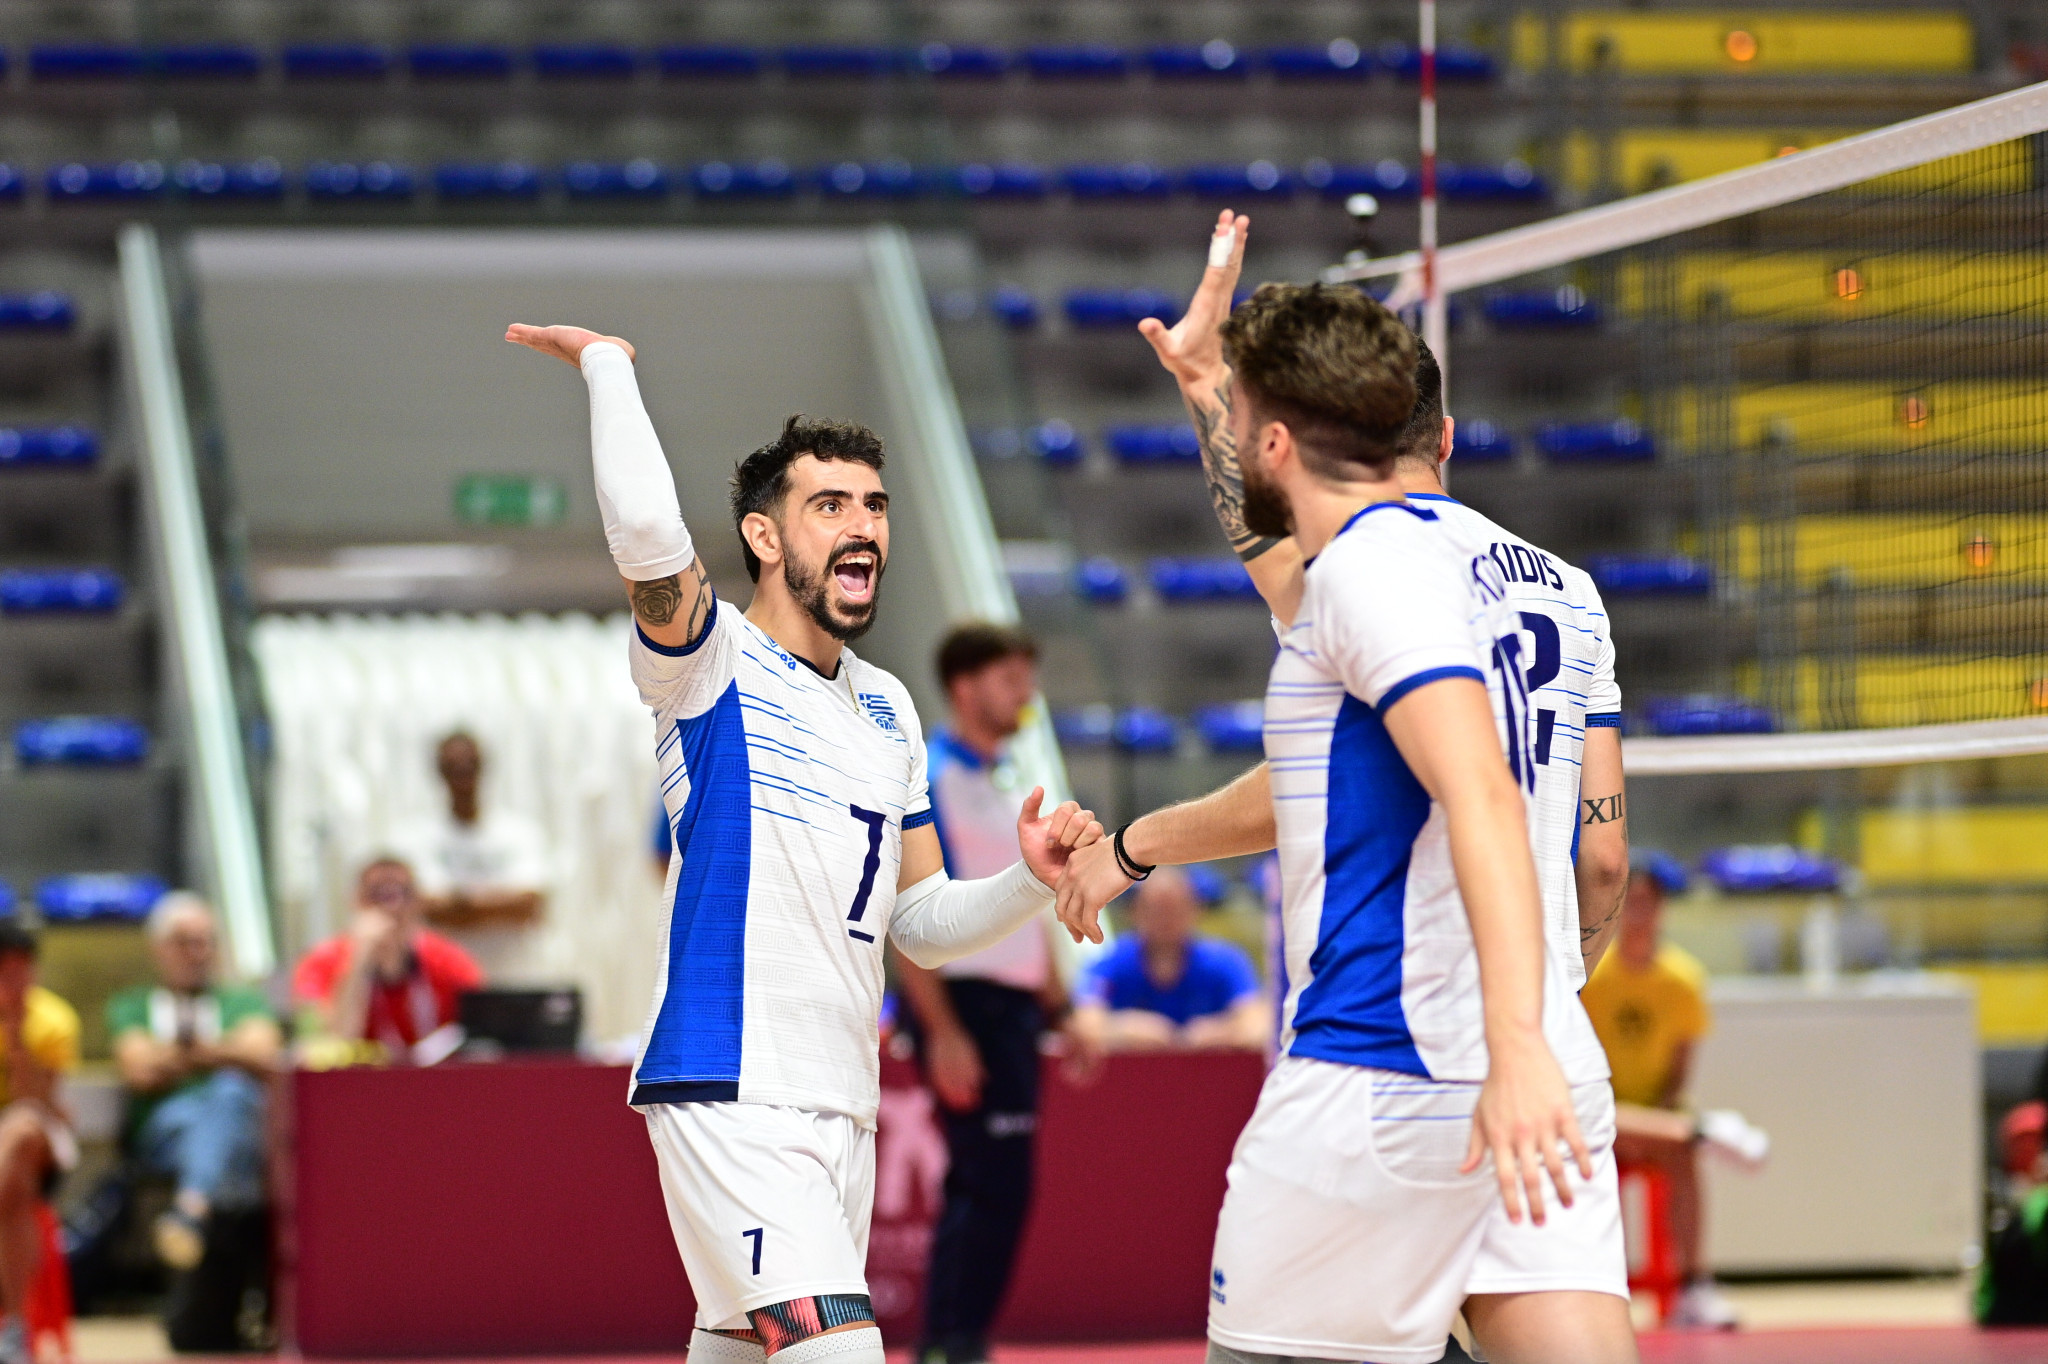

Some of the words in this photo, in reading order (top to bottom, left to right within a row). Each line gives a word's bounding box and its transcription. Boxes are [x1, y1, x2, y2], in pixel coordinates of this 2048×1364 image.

[1583, 793, 1623, 825] XII
[847, 803, 887, 923] 7
[742, 1227, 763, 1276] 7
